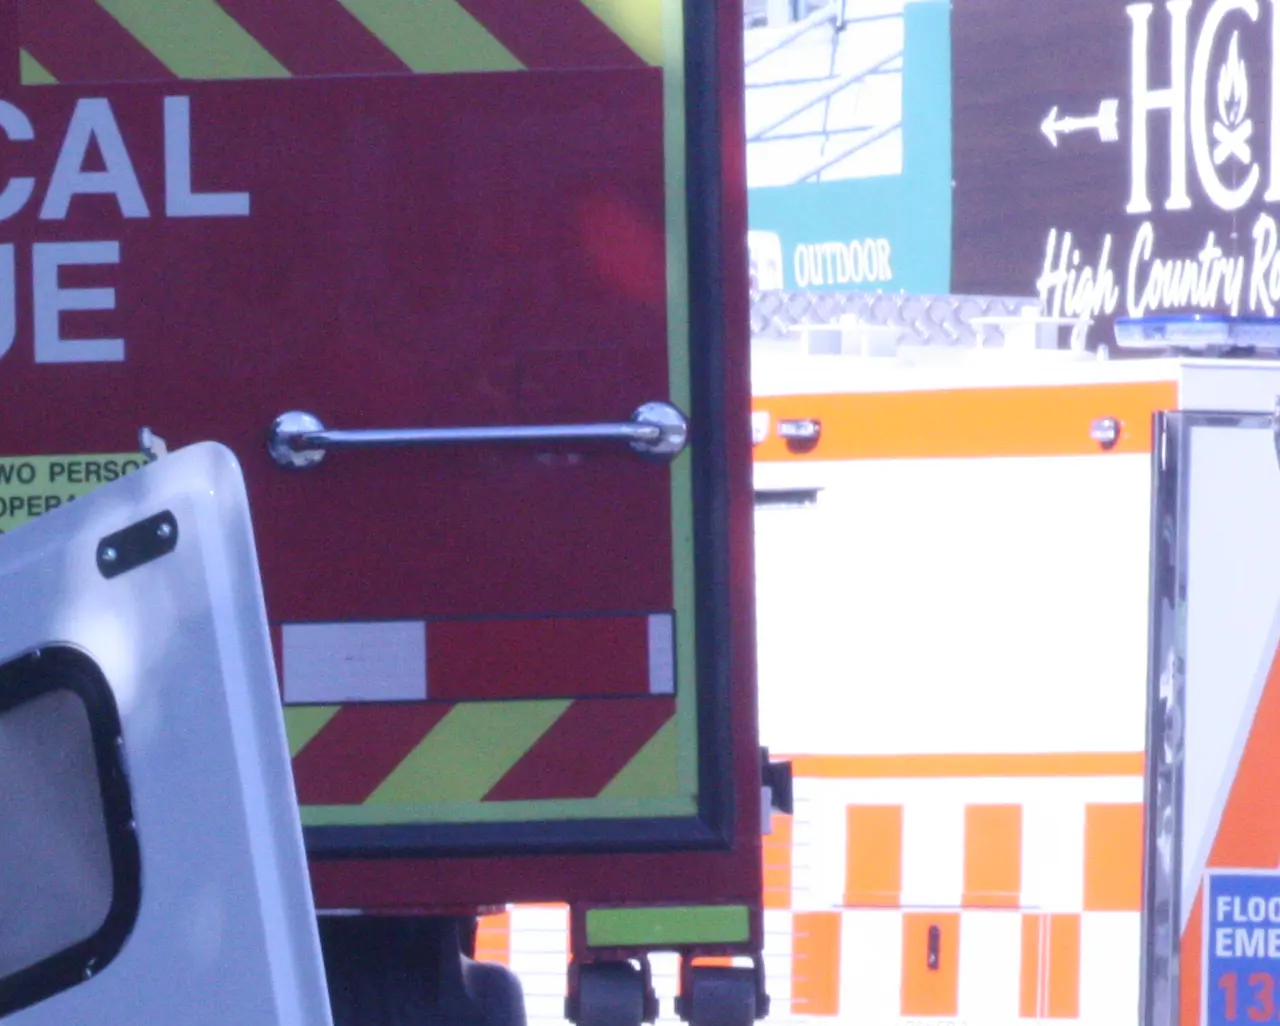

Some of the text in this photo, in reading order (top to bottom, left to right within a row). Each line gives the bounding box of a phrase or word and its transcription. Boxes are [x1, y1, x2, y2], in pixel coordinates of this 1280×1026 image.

[1125, 0, 1280, 213] HC
[793, 238, 893, 287] OUTDOOR
[1037, 227, 1119, 355] High
[1126, 220, 1245, 318] Country
[48, 459, 152, 483] PERSO
[1218, 971, 1280, 1022] 13
